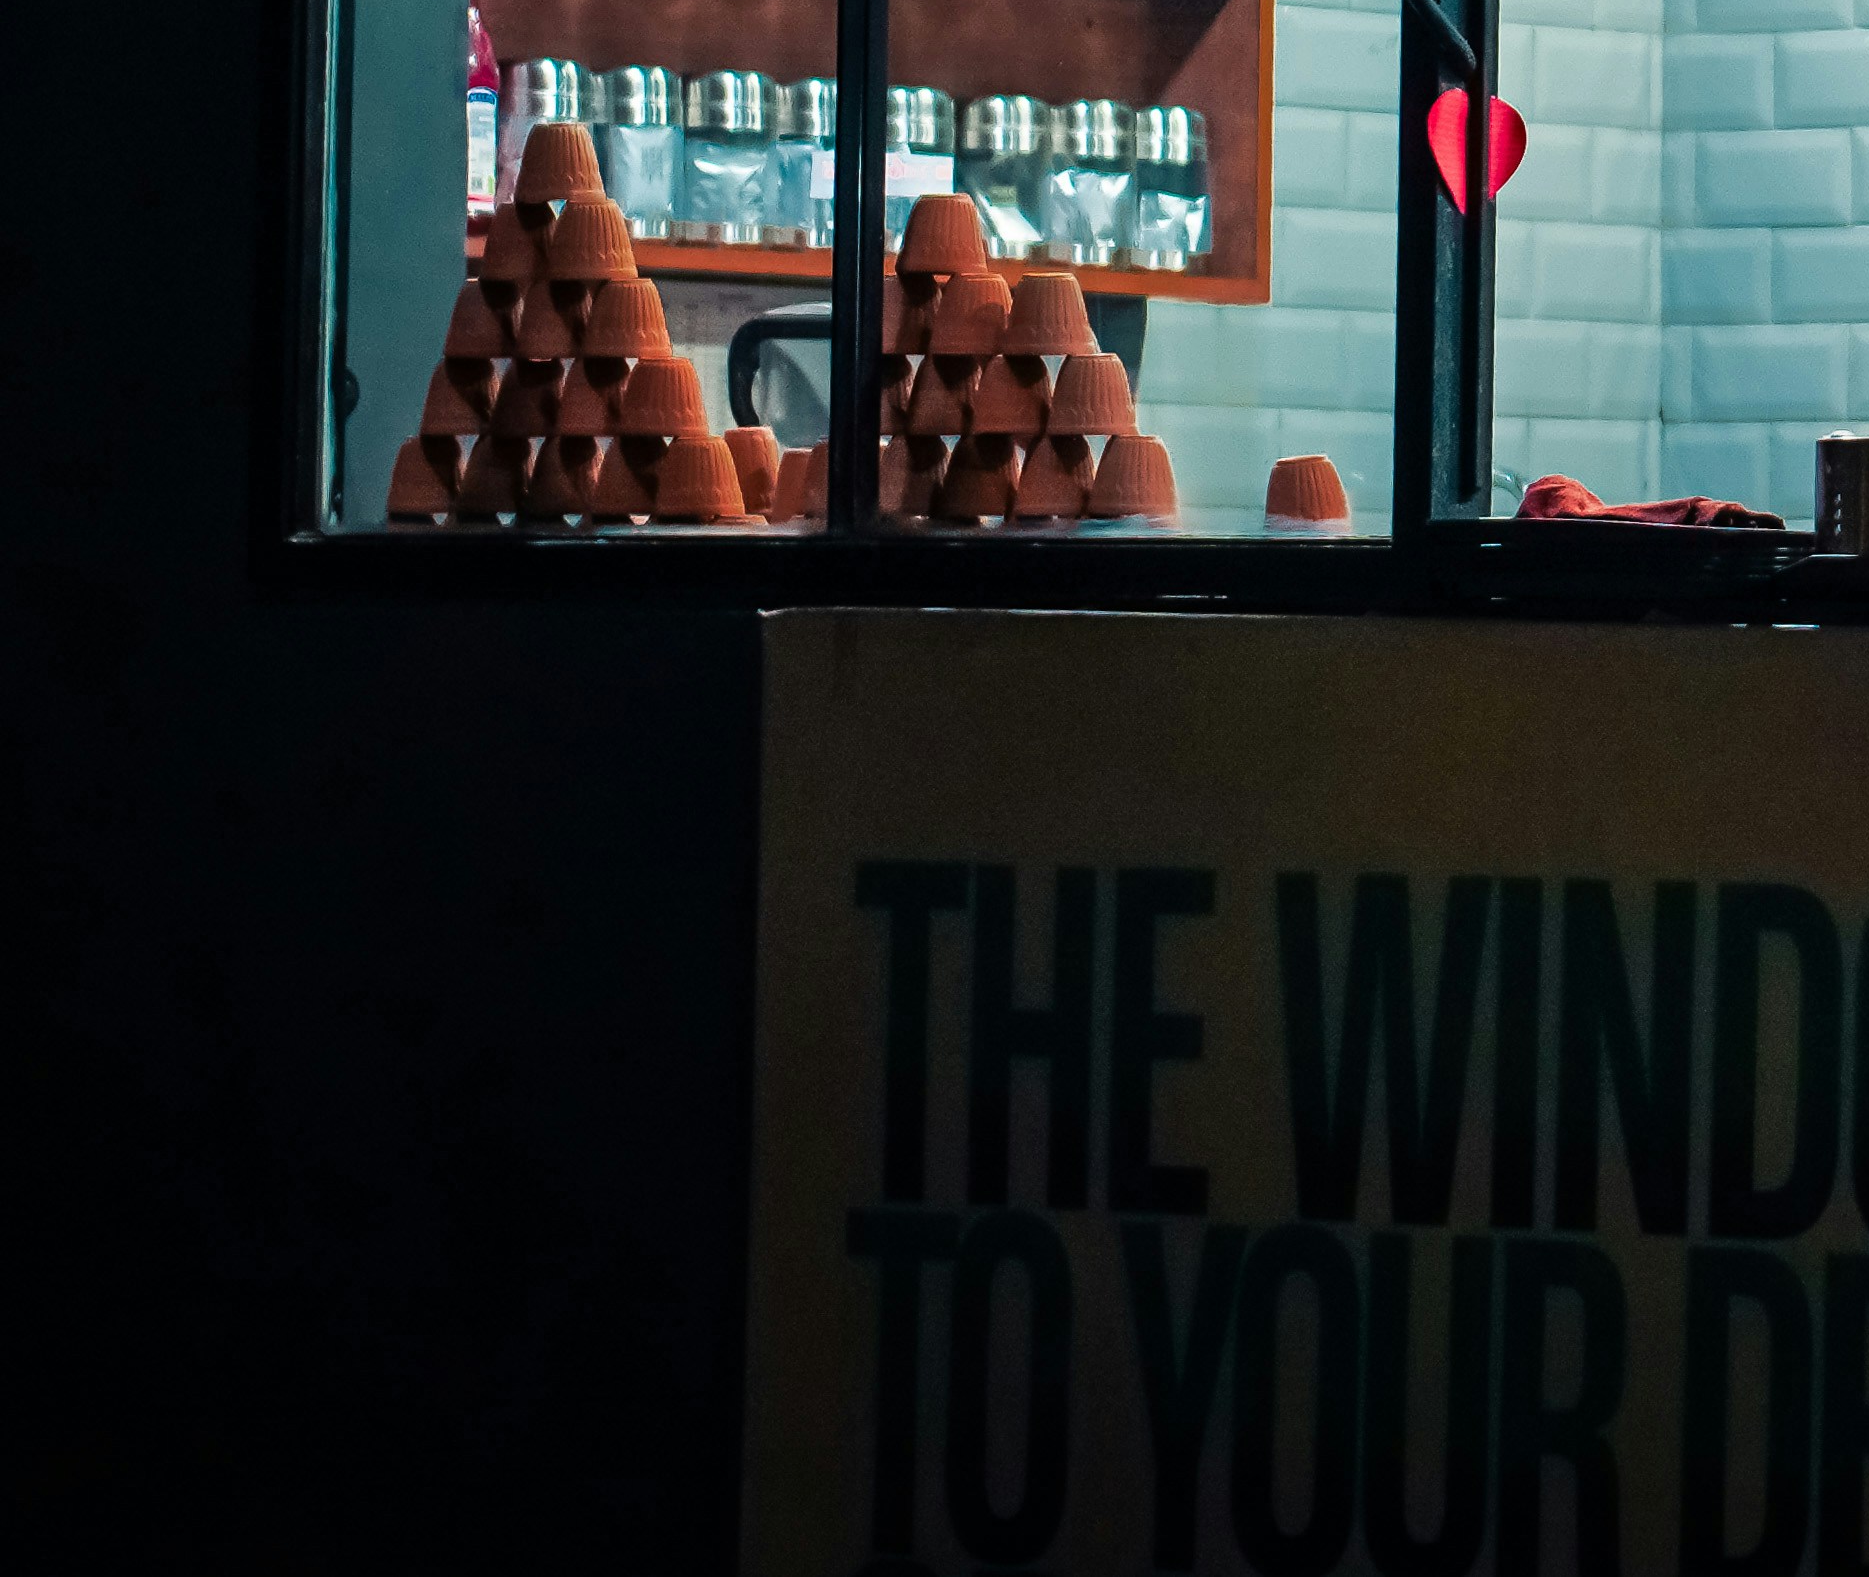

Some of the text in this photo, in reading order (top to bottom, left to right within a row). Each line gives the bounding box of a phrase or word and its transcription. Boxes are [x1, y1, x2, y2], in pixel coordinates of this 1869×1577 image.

[855, 860, 1217, 1211] THE
[846, 1209, 1071, 1563] TO
[1121, 1221, 1626, 1577] YOUR
